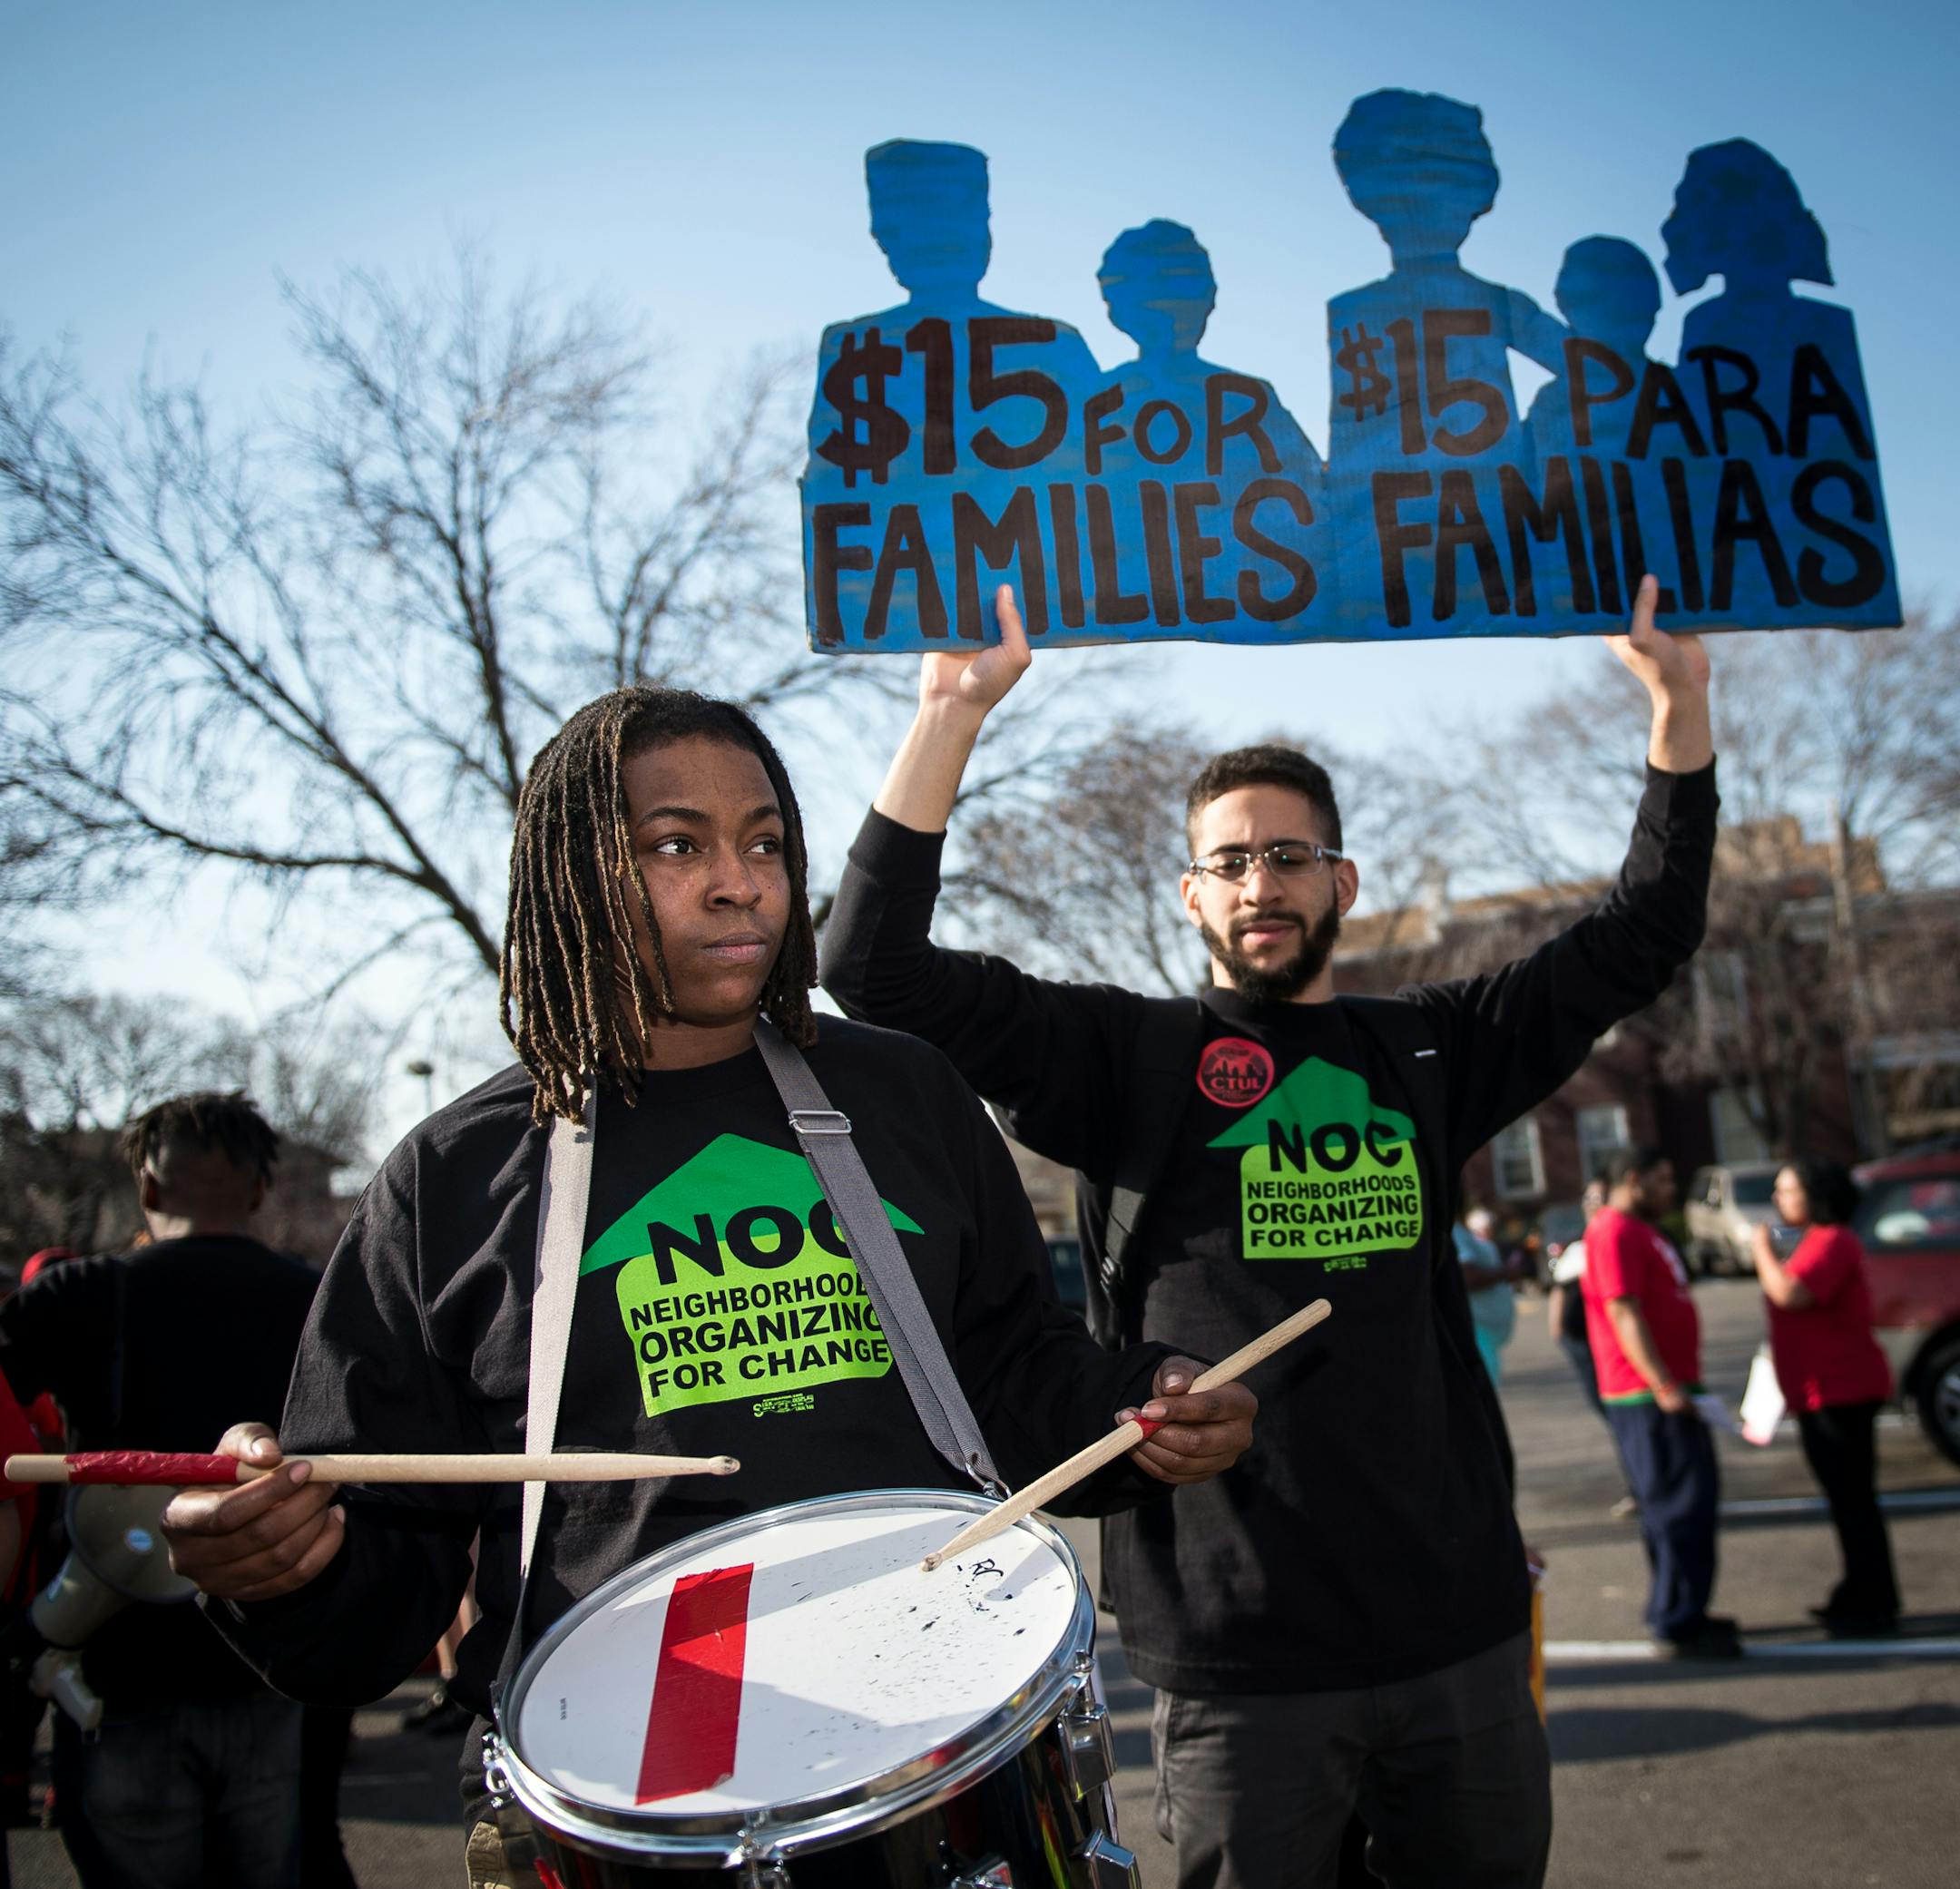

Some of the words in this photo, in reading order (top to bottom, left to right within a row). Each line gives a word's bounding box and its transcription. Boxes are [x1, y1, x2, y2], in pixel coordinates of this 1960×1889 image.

[817, 317, 1068, 488] $15
[1083, 373, 1282, 475] FOR
[1336, 308, 1509, 455] $15
[1563, 337, 1877, 460] PARA
[812, 478, 1318, 646] FAMILIES
[1371, 455, 1886, 628] FAMILIAS
[1210, 1077, 1260, 1090] CTUL
[1268, 1119, 1403, 1174] NOC
[1247, 1175, 1416, 1199] NEIGHBORHOODS
[1247, 1194, 1418, 1225] ORGANIZING
[1250, 1229, 1307, 1247] FOR
[1315, 1219, 1418, 1247] CHANGE
[630, 1272, 868, 1331] NEIGHBORHOO
[648, 1361, 726, 1397] FOR
[739, 1337, 889, 1379] CHANGE
